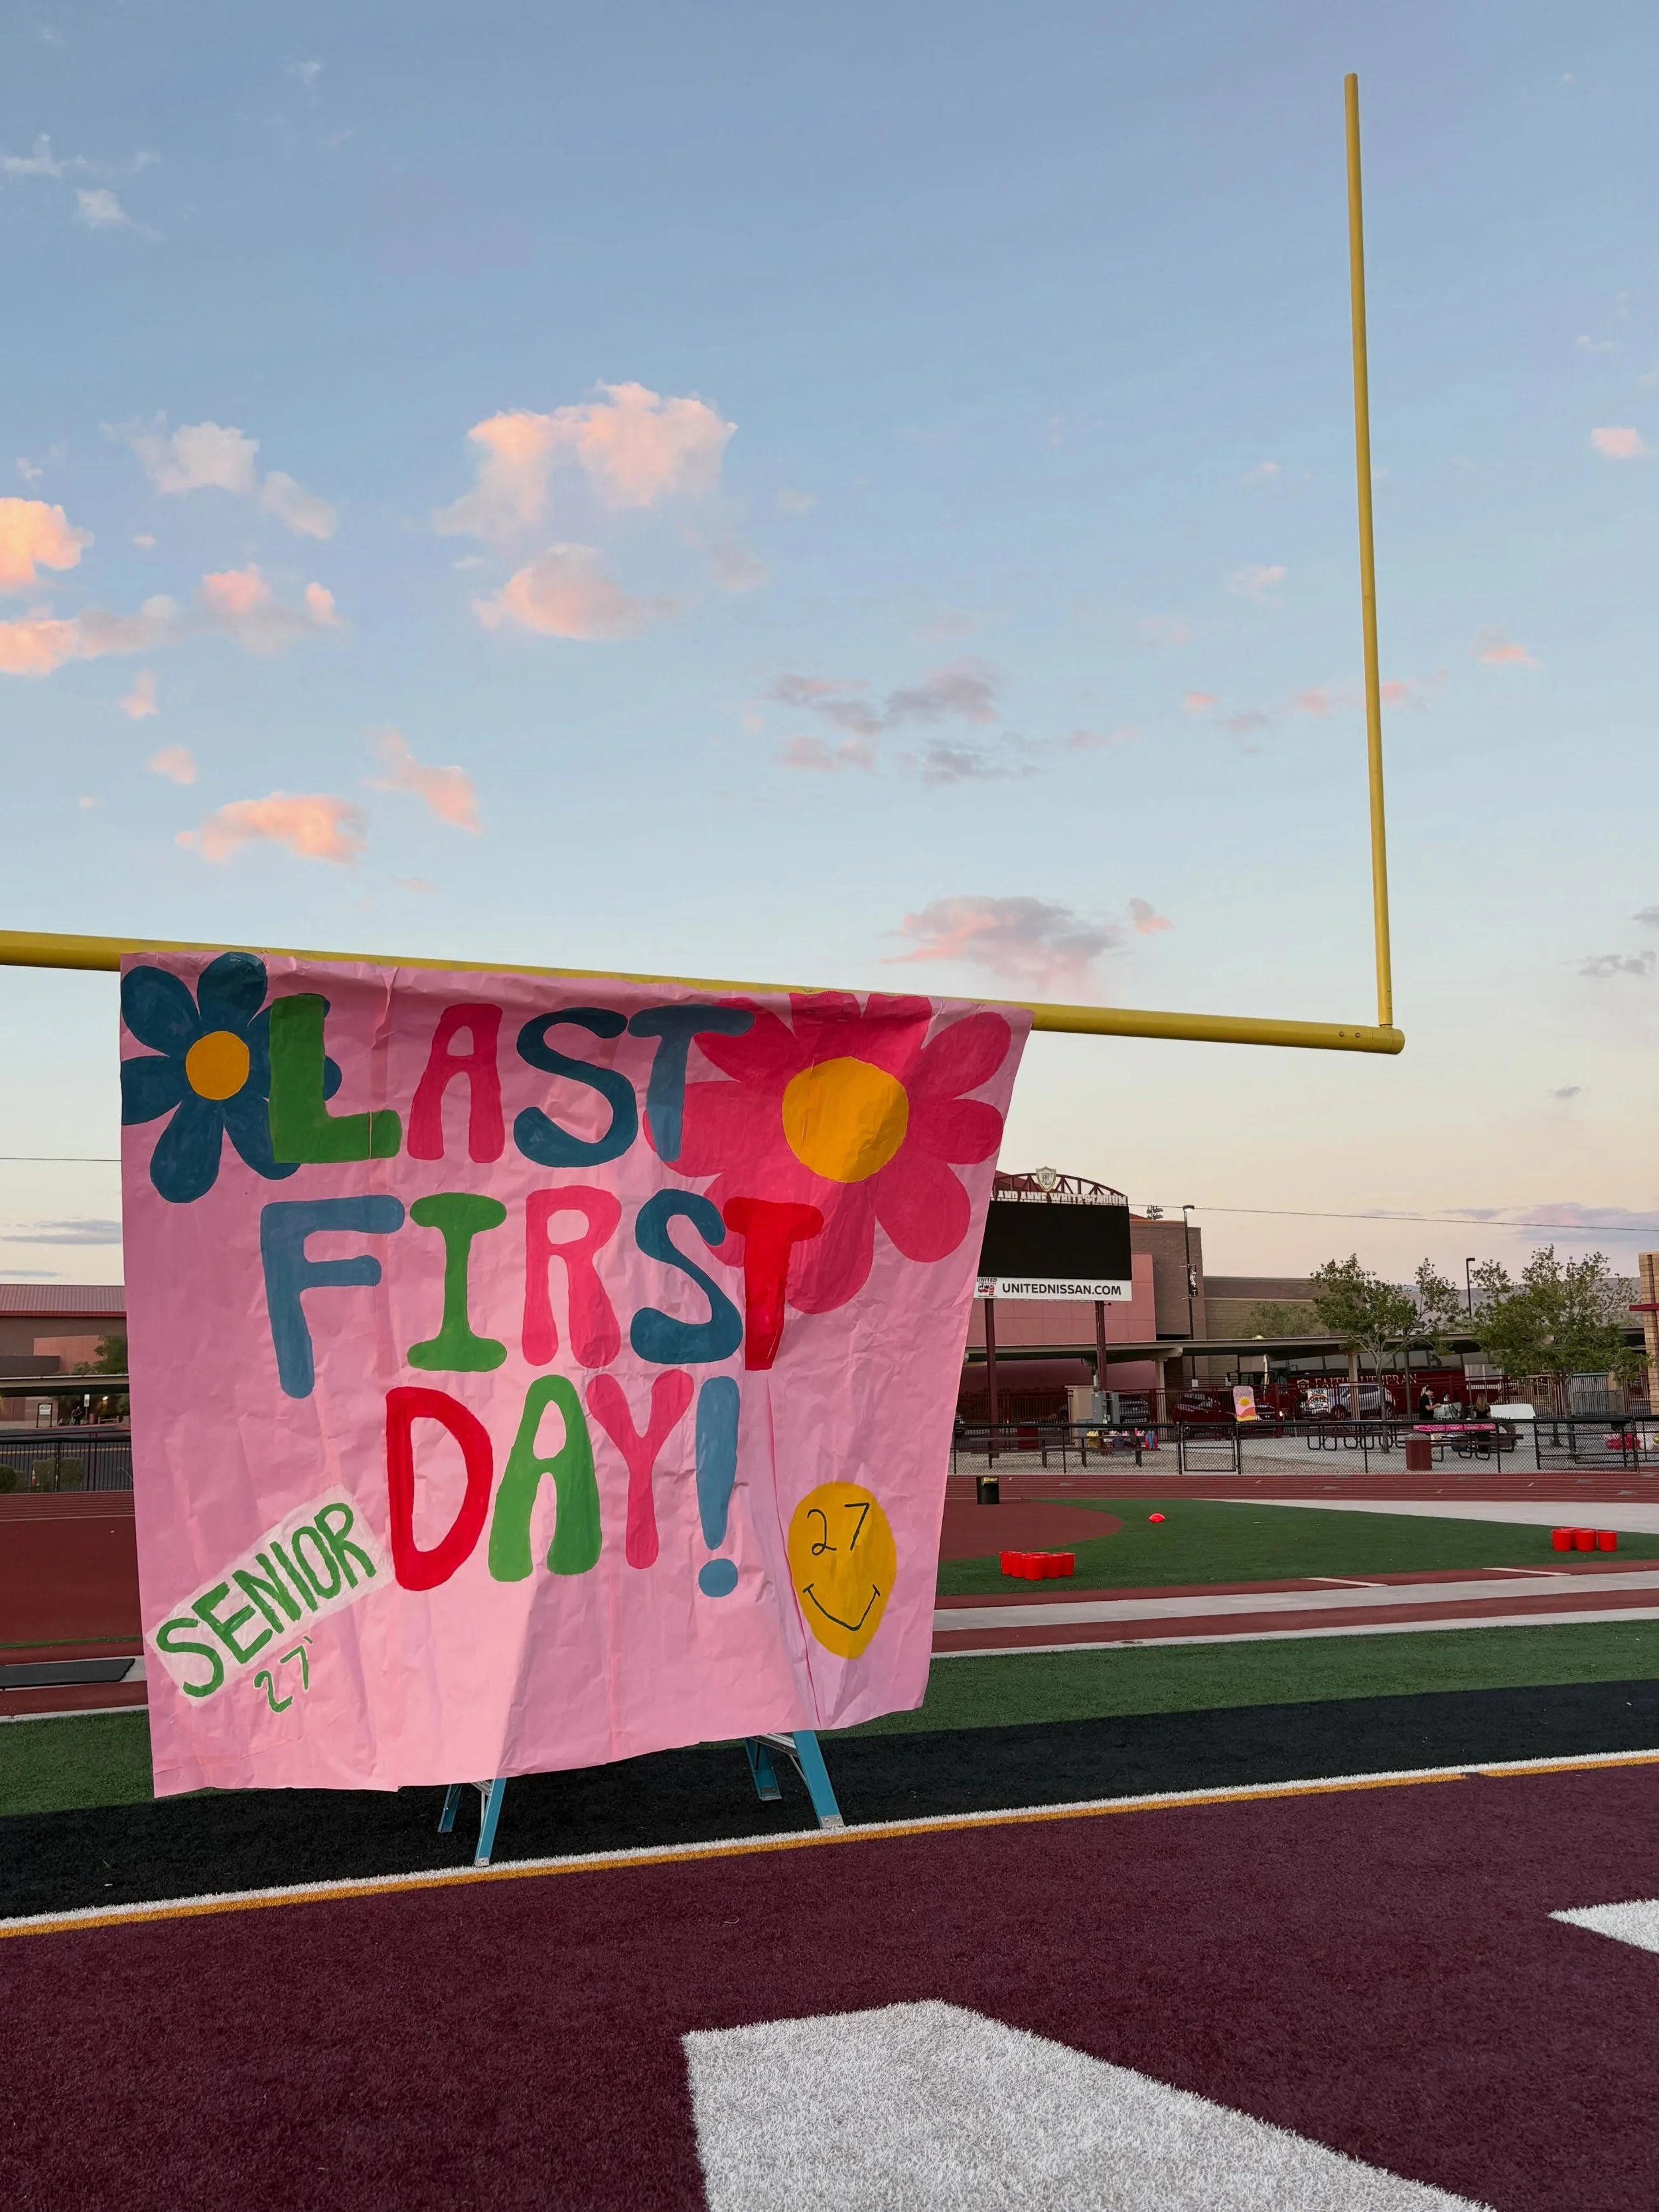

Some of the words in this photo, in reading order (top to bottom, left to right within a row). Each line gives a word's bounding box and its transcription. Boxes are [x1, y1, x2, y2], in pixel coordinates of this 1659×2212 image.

[268, 994, 756, 1167] LAST
[997, 1190, 1019, 1202] AND
[1020, 1191, 1048, 1203] ANNE
[1050, 1193, 1084, 1205] WHITE
[1084, 1195, 1127, 1207] STADIUM
[260, 1185, 824, 1398] FIRST
[1002, 1283, 1121, 1295] UNITEDNISSAN.COM
[386, 1370, 741, 1597] DAY!
[807, 1503, 870, 1556] 27
[156, 1502, 377, 1698] SENIOR
